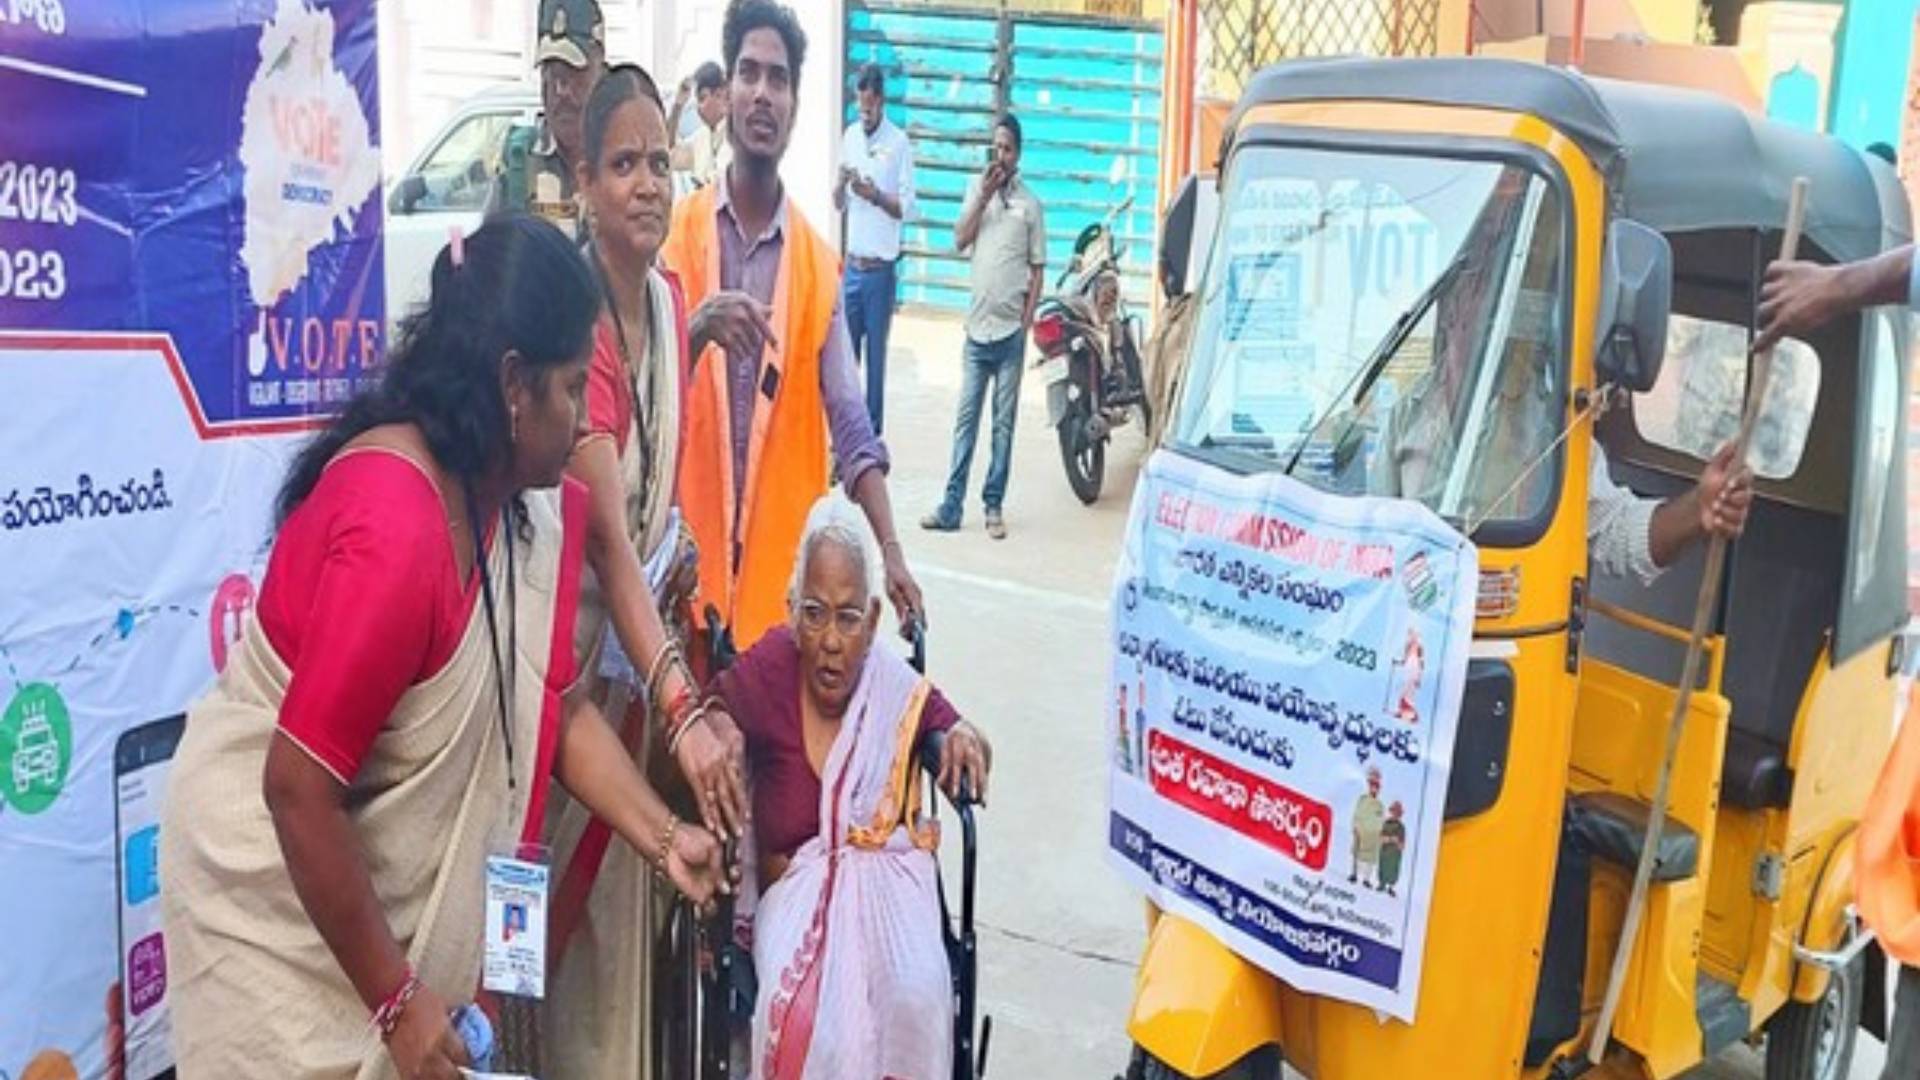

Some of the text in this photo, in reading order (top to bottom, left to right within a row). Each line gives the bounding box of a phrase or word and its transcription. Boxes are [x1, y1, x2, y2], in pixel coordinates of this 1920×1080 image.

[269, 94, 342, 167] VOTE
[0, 160, 78, 227] 2023
[1333, 638, 1378, 672] 2023
